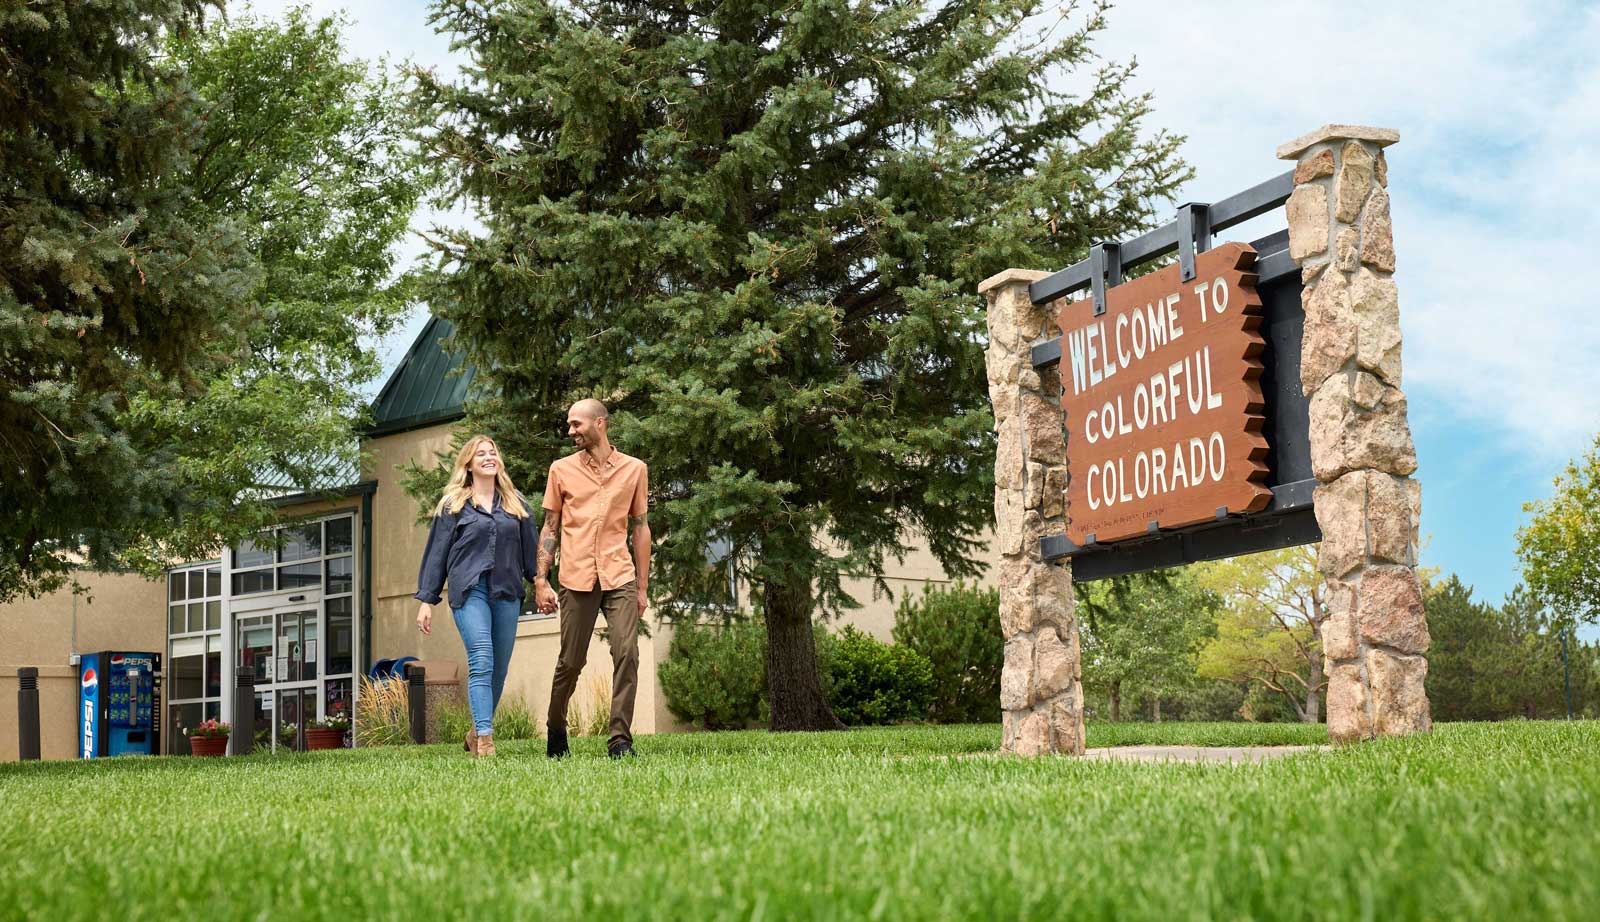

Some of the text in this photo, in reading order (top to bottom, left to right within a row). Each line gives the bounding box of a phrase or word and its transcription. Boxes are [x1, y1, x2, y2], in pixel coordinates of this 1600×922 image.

[1068, 276, 1229, 396] WELCOME TO
[1085, 345, 1222, 444] COLORFUL
[1087, 431, 1226, 510] COLORADO
[123, 657, 152, 665] PEPSI
